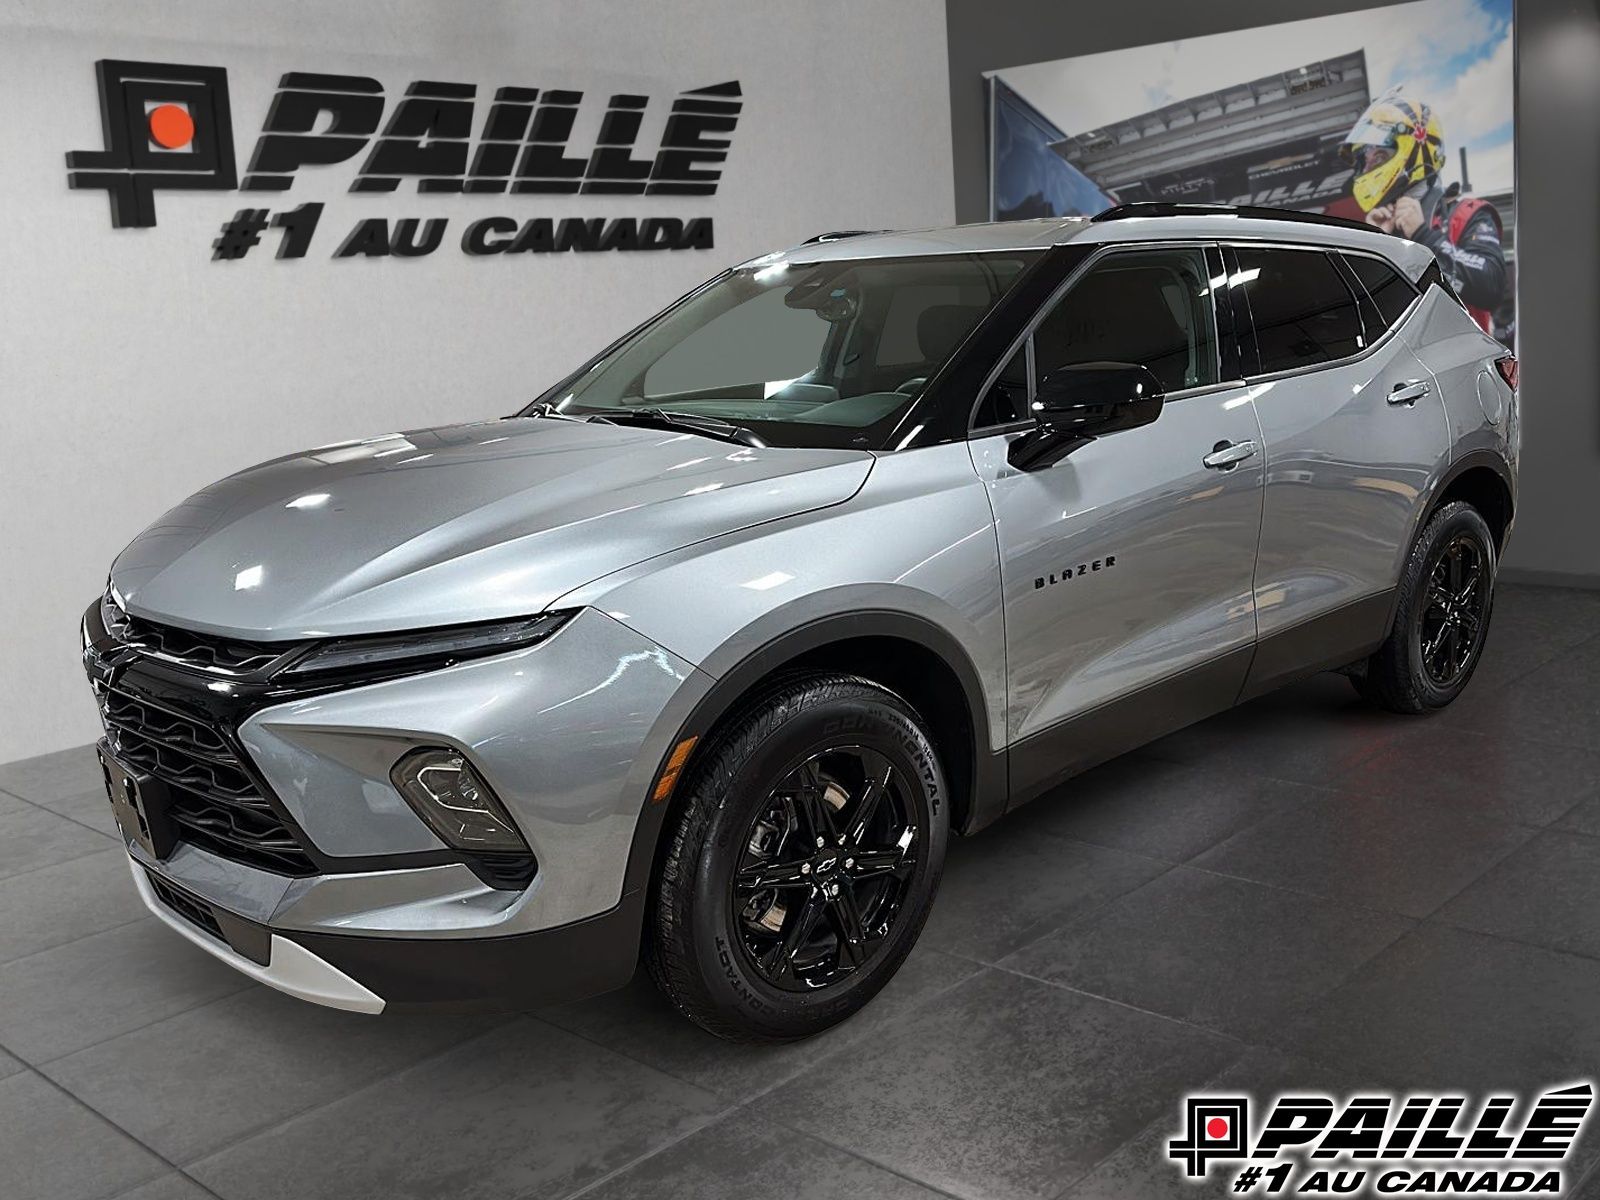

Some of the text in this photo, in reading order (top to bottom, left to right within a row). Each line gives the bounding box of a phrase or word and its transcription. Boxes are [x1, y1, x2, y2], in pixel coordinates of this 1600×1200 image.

[239, 71, 743, 195] PAILLÉ
[211, 202, 714, 261] #1 AU CANADA
[1034, 556, 1116, 589] BLAZER
